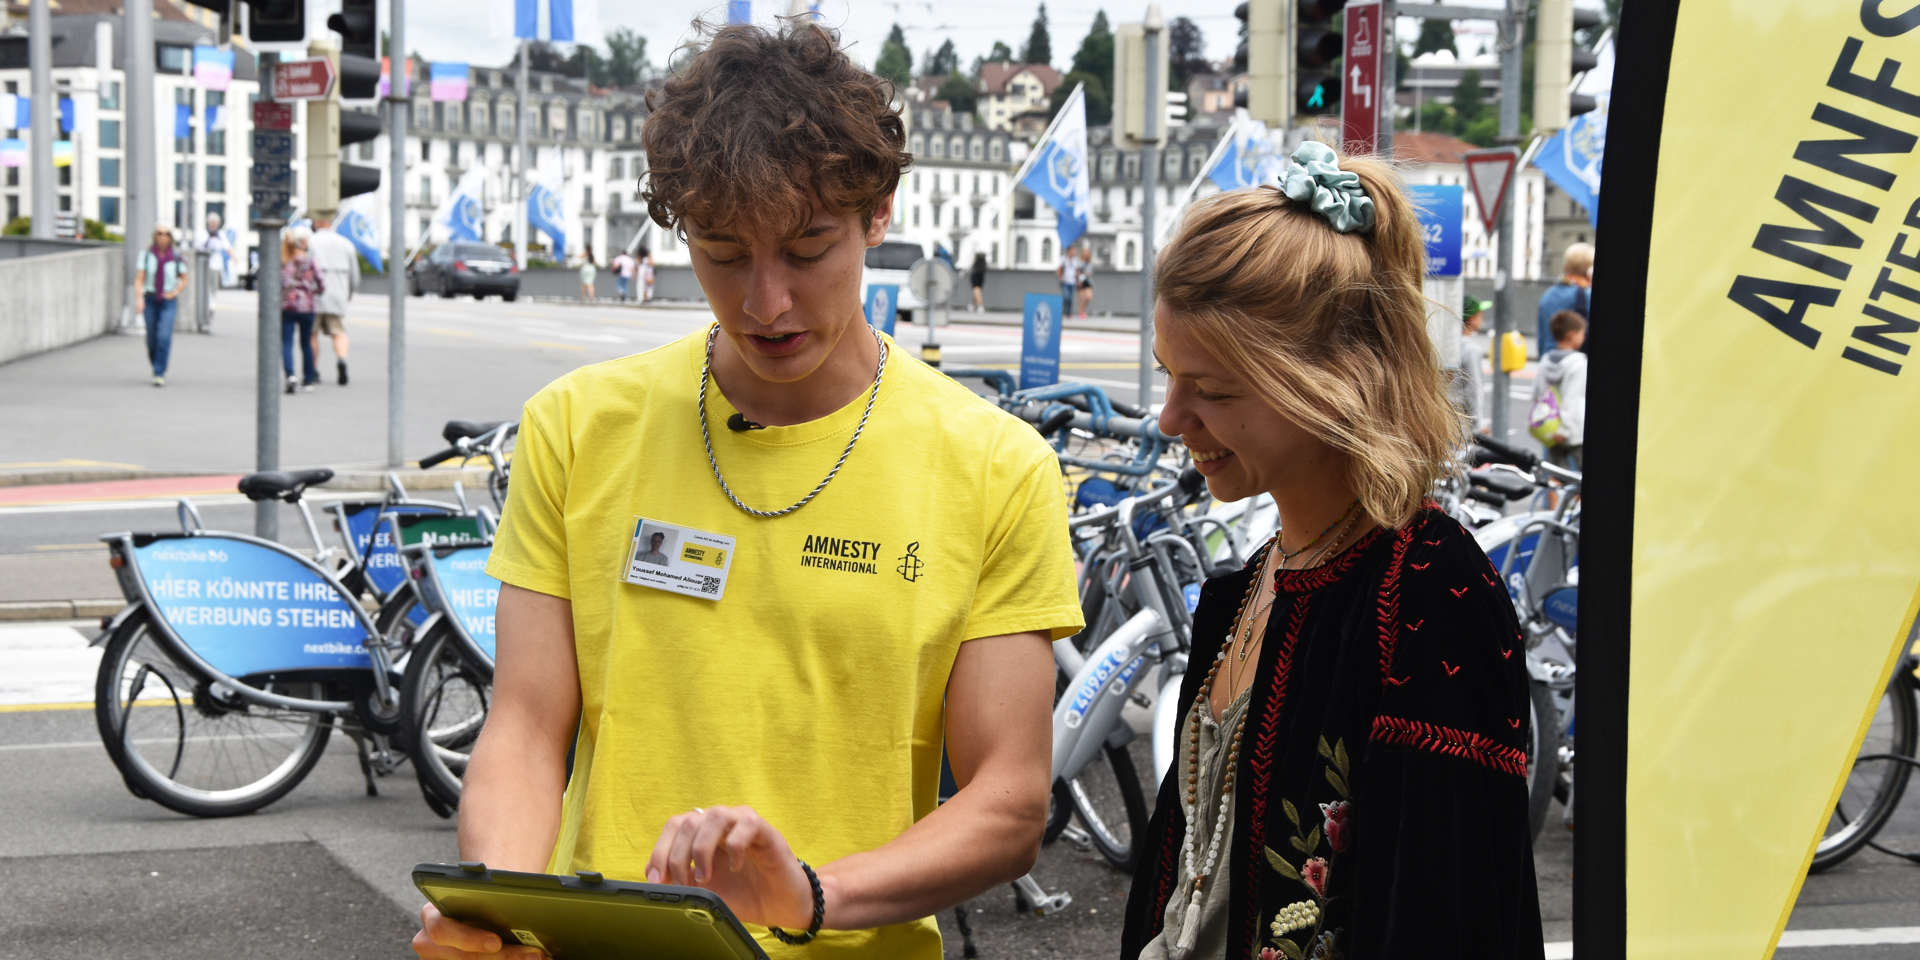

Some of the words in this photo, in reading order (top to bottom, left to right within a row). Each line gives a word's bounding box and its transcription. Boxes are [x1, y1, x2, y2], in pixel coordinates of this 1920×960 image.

[152, 549, 207, 562] nextbike
[685, 547, 705, 556] AMNESTY
[802, 534, 881, 560] AMNESTY
[632, 565, 655, 575] Youssef
[655, 570, 682, 581] Mohamed
[801, 555, 878, 574] INTERNATIONAL
[153, 579, 200, 599] HIER
[207, 577, 289, 600] KÖNNTE
[294, 582, 341, 601] IHRE
[165, 606, 272, 627] WERBUNG
[276, 608, 356, 629] STEHEN
[1076, 659, 1117, 709] 40961
